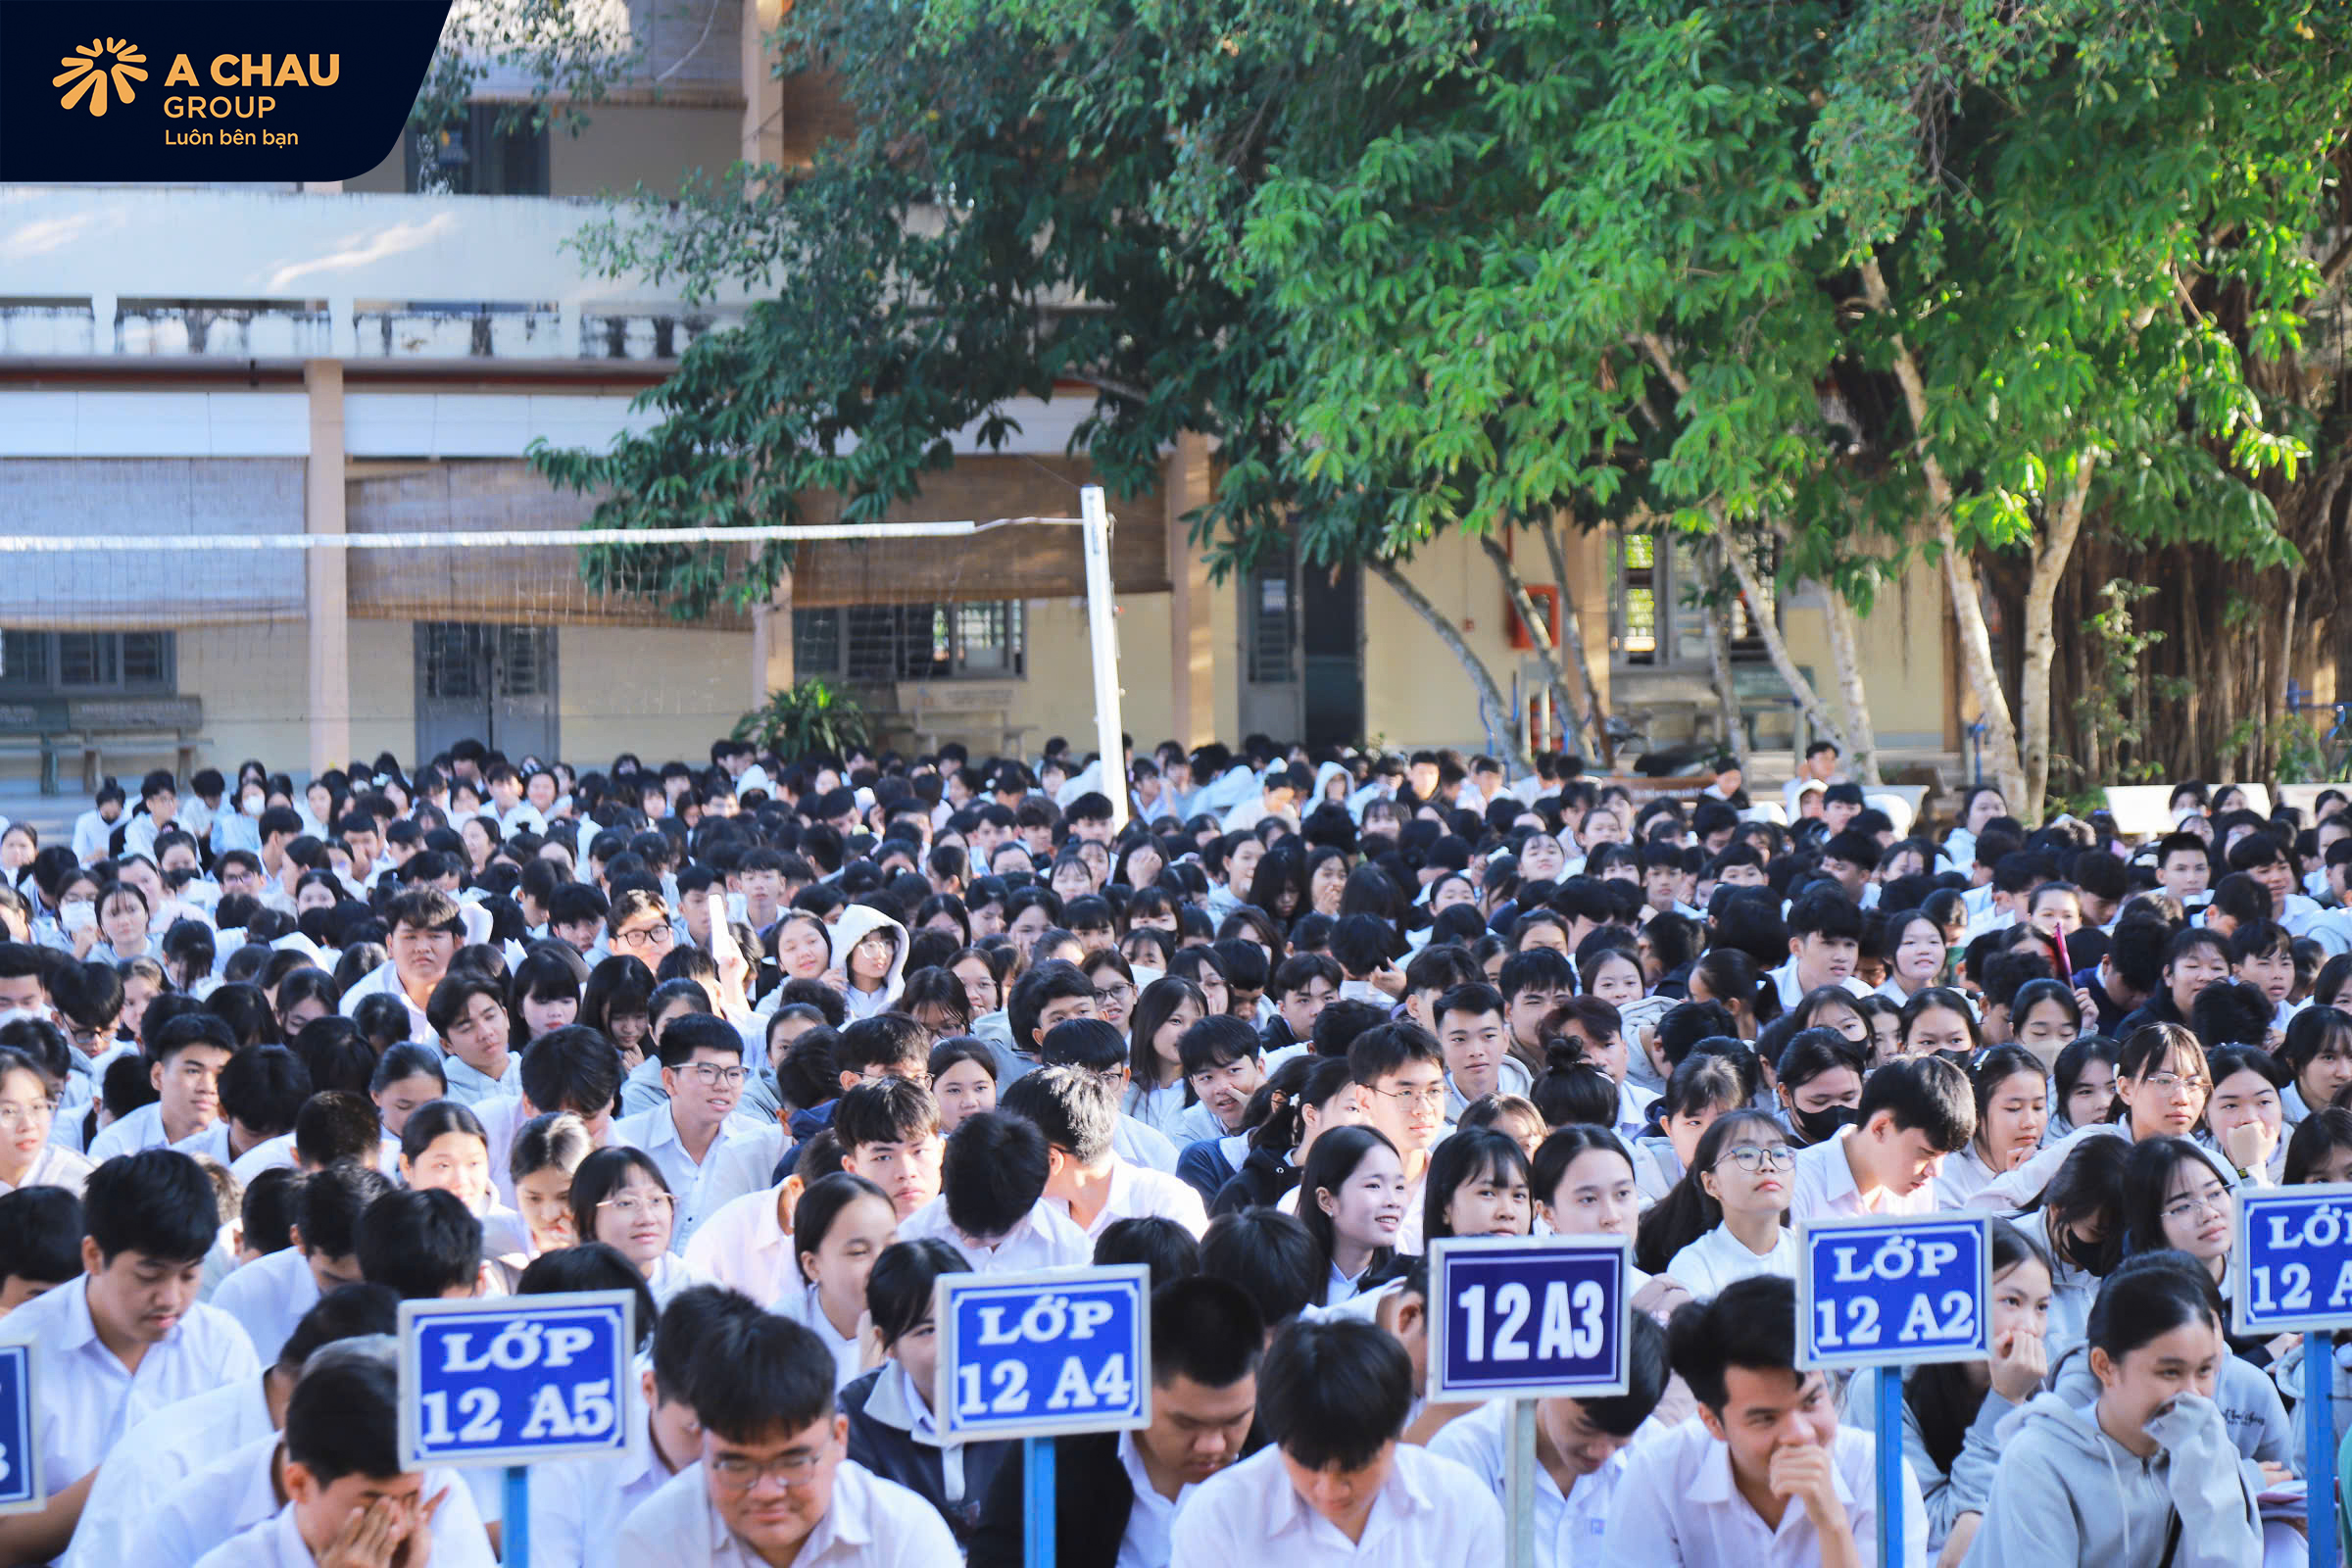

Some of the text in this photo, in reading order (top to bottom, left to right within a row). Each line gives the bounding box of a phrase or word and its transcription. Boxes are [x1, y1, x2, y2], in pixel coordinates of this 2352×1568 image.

[2267, 1203, 2352, 1250] LỚ
[1833, 1235, 1958, 1283] LỚP
[2252, 1262, 2313, 1311] 12
[977, 1294, 1114, 1346] LỚP
[1816, 1290, 1976, 1347] 12 A2
[441, 1320, 595, 1372] LỚP
[959, 1352, 1132, 1415] 12 A4
[421, 1378, 614, 1445] 12 A5
